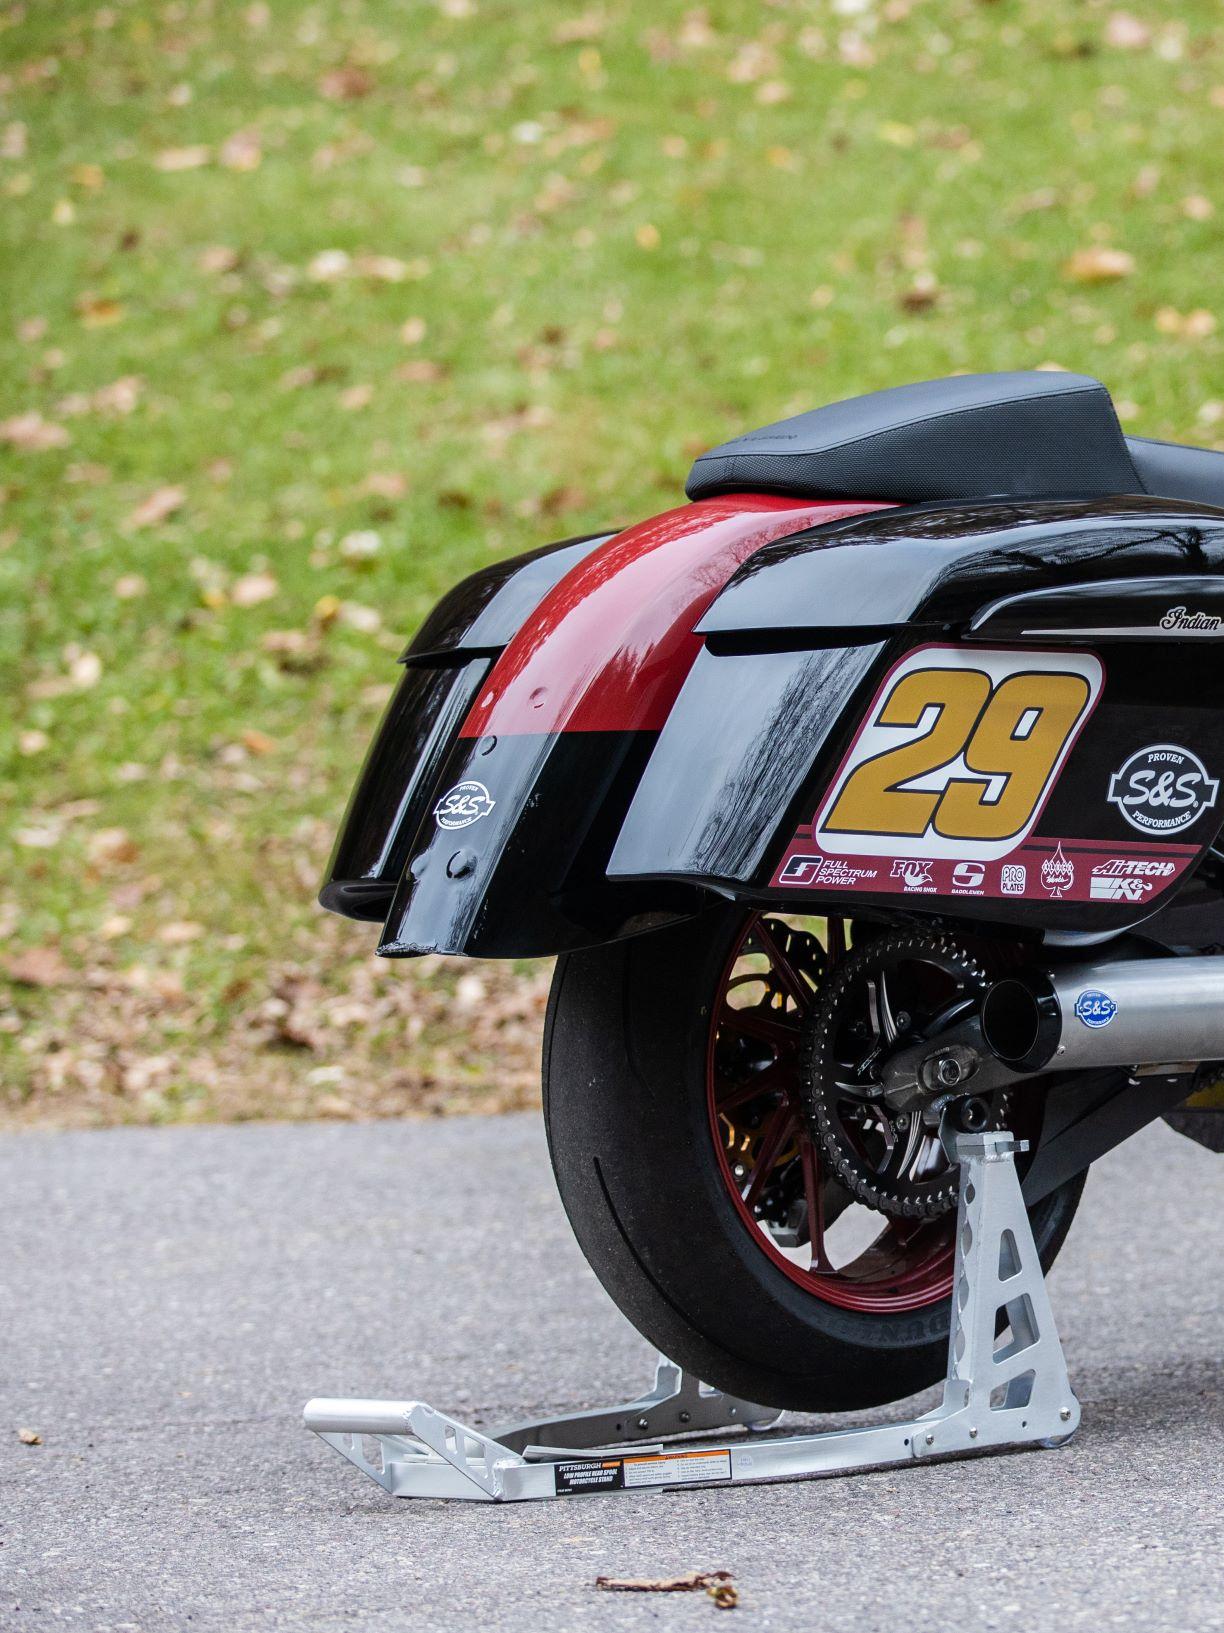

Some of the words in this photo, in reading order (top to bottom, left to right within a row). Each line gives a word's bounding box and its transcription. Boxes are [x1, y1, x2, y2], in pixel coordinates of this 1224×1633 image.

[1161, 607, 1221, 631] Indian
[818, 666, 1092, 842] 29
[1147, 752, 1185, 765] PROVEN
[1122, 769, 1202, 808] S&S
[439, 794, 486, 815] S&S
[1132, 810, 1192, 828] PERFORMANCE
[818, 867, 878, 878] SPECTRUM
[822, 860, 849, 869] FULL
[890, 860, 934, 878] FOX
[815, 876, 857, 886] POWER
[1002, 866, 1025, 883] PRO
[1002, 883, 1025, 892] PLATES
[1082, 1000, 1111, 1016] S&S
[559, 1463, 602, 1472] PITTSBURGH
